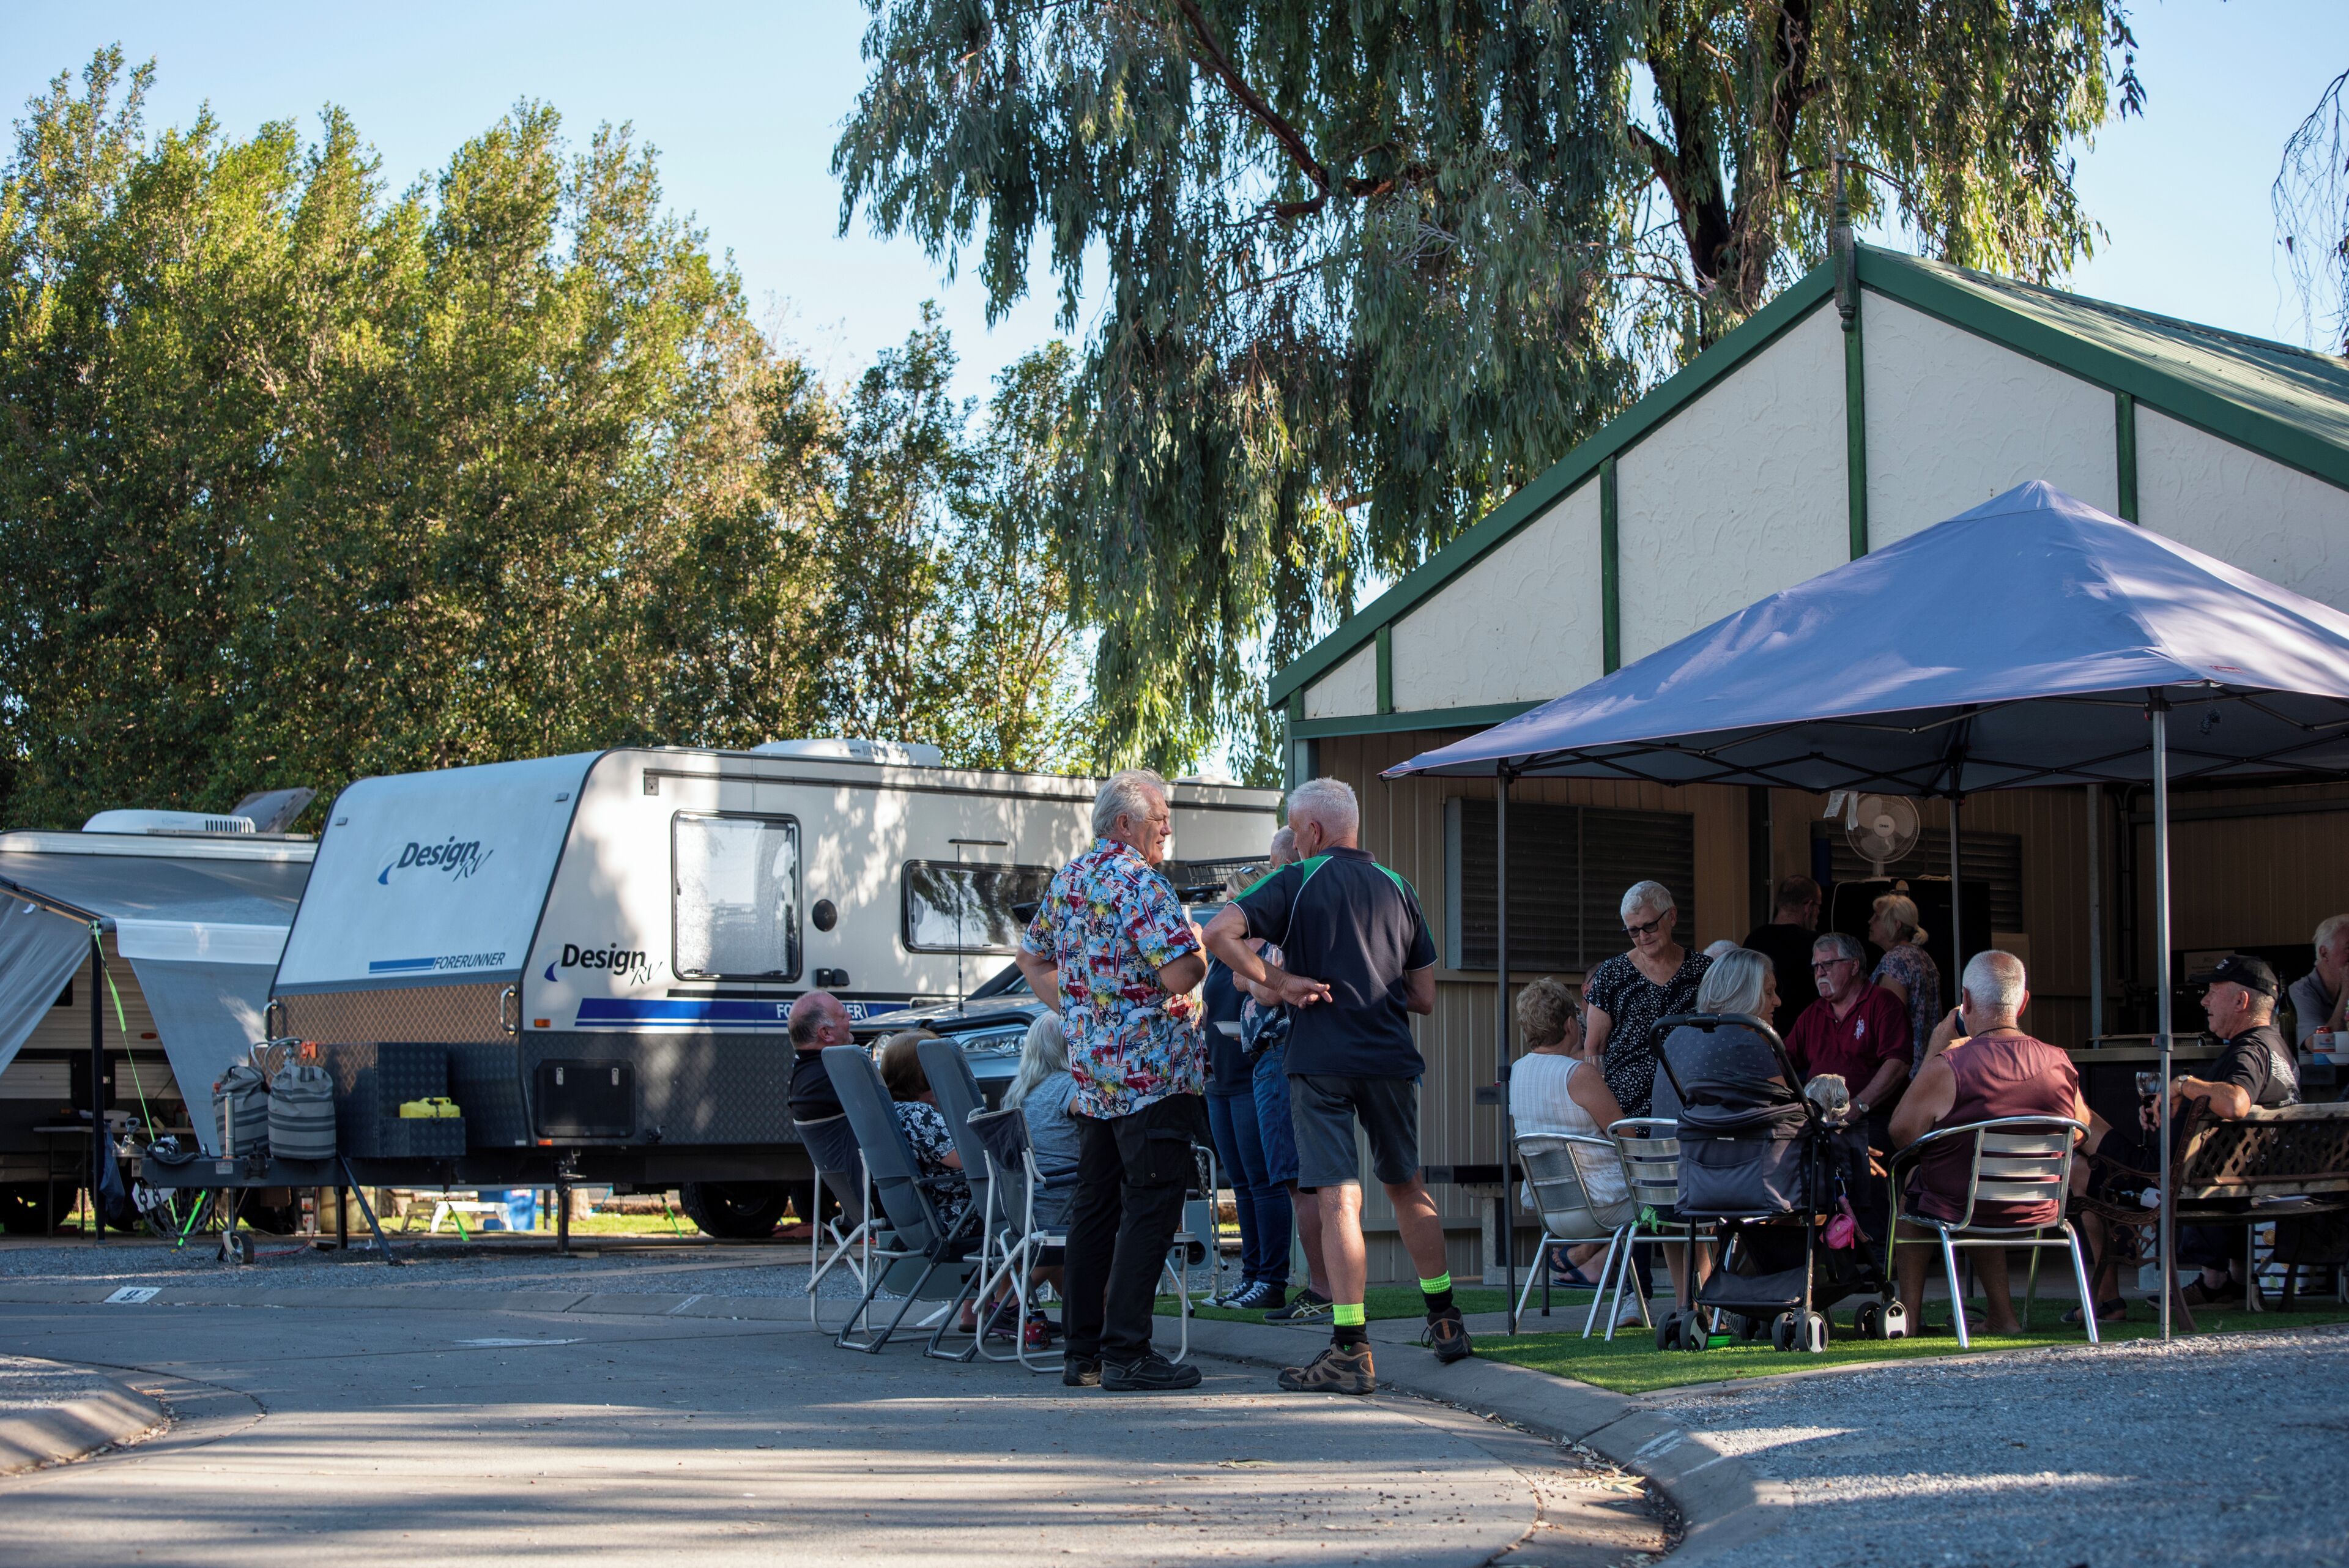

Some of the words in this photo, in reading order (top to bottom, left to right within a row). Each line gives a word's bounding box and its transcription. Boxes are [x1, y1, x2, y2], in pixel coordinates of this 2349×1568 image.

[396, 836, 480, 872] Design
[453, 849, 494, 882] RV
[433, 952, 506, 970] FORERUNNER
[561, 942, 646, 976] Design
[630, 961, 662, 986] RV
